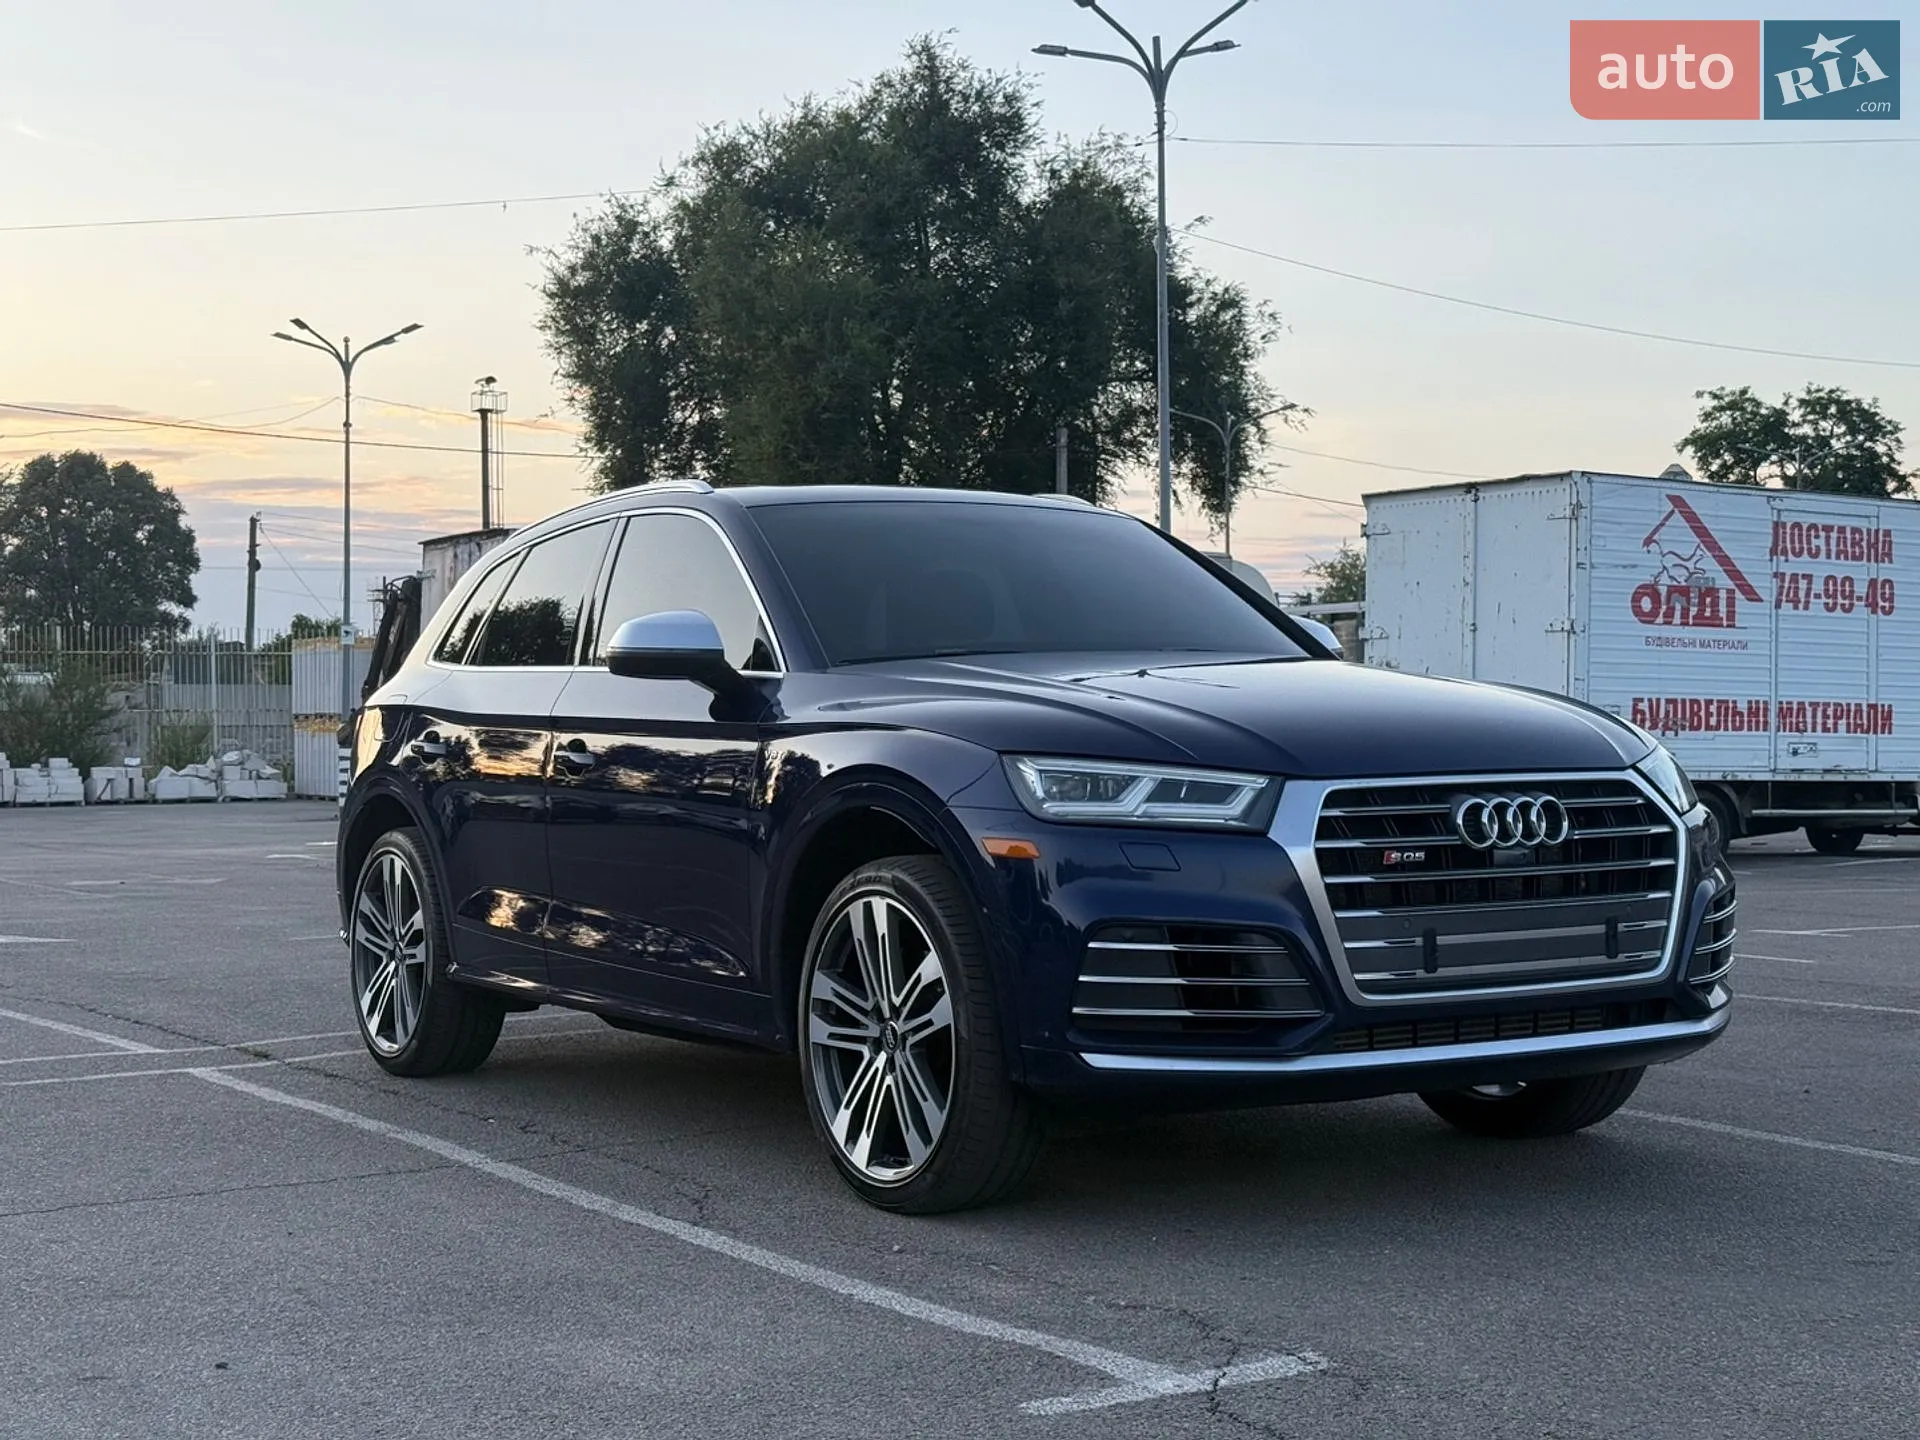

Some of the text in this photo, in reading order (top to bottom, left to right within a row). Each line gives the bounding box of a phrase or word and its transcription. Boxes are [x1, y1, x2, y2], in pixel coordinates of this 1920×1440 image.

[1631, 583, 1736, 628] ОЛДІ
[1773, 571, 1895, 616] 747-99-49
[1644, 635, 1748, 651] БУДІВЕЛЬНІ МАТЕРІАЛИ
[1631, 697, 1893, 737] БУДІВЕЛЬНІ МАТЕРІАЛИ
